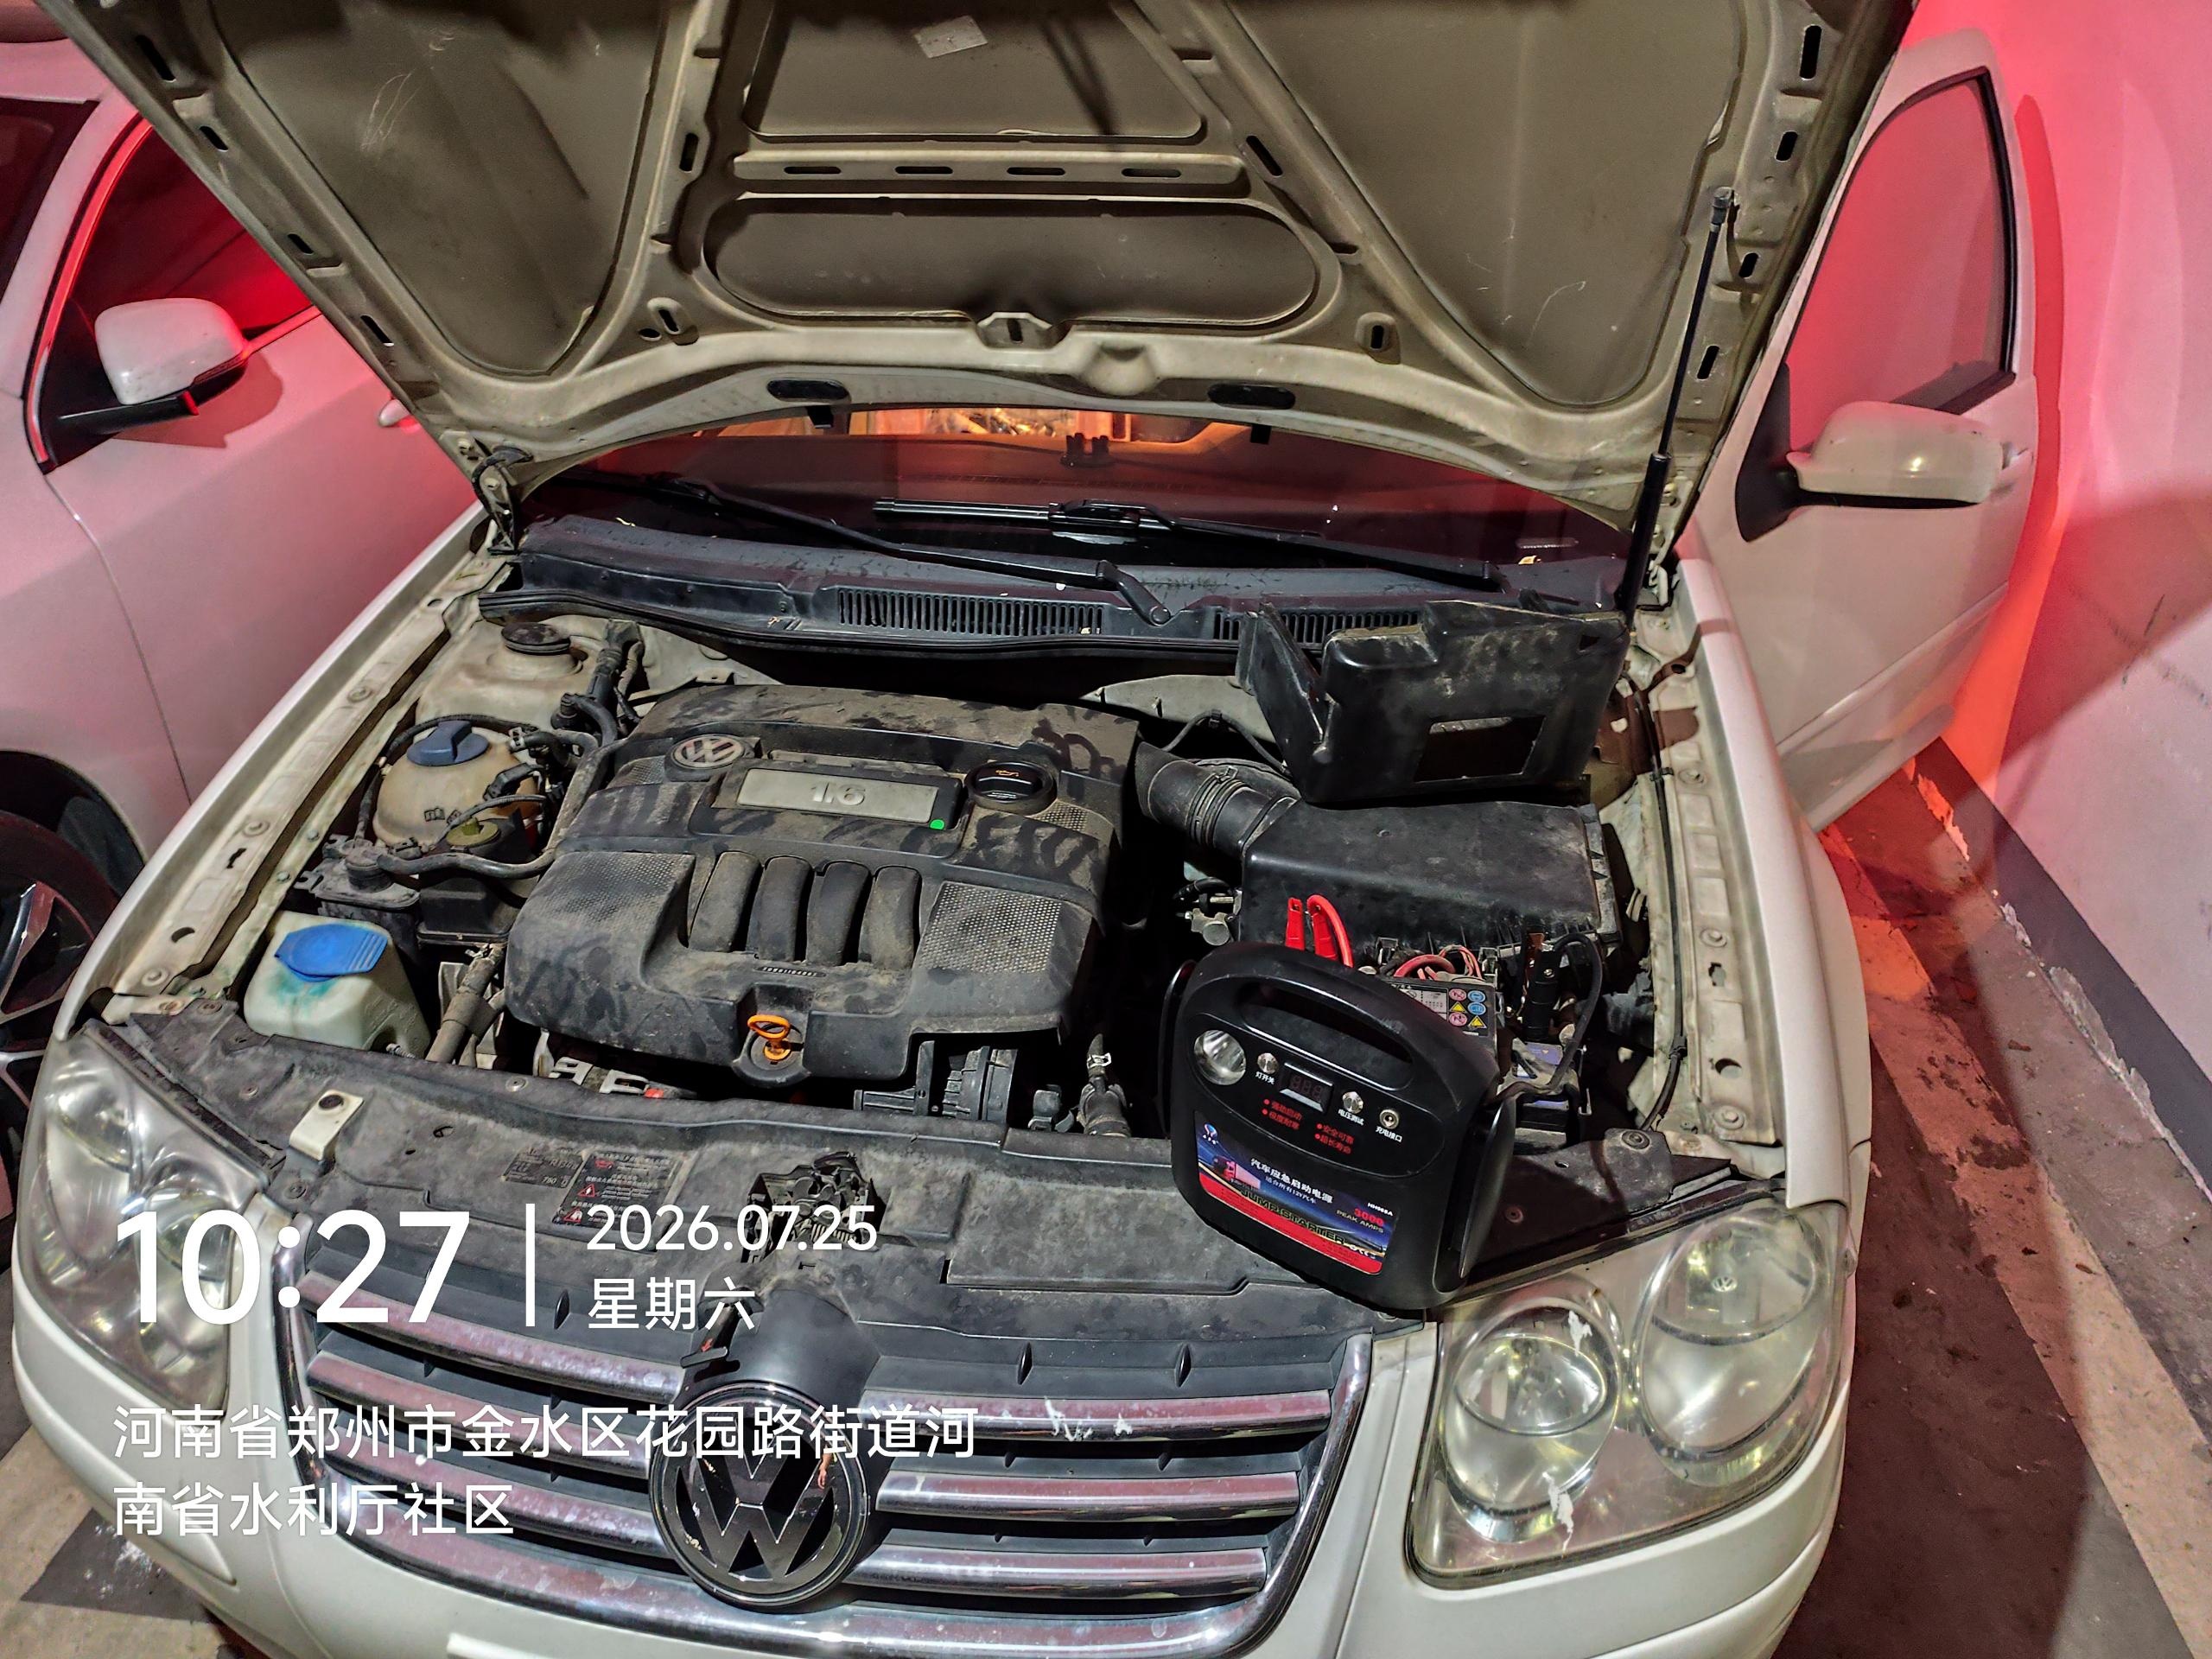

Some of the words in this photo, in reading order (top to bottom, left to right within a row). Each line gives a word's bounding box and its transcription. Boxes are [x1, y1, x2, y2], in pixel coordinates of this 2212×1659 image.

[1255, 1071, 1274, 1085] 灯开关
[1338, 1109, 1365, 1126] 电压测试
[1376, 1126, 1403, 1143] 充电接口
[1250, 1158, 1333, 1204] 汽车应急启动电源
[1240, 1191, 1278, 1213] JUMP
[1279, 1208, 1345, 1244] STARTER
[1336, 1210, 1358, 1223] PEAK
[1360, 1220, 1384, 1233] AMPS
